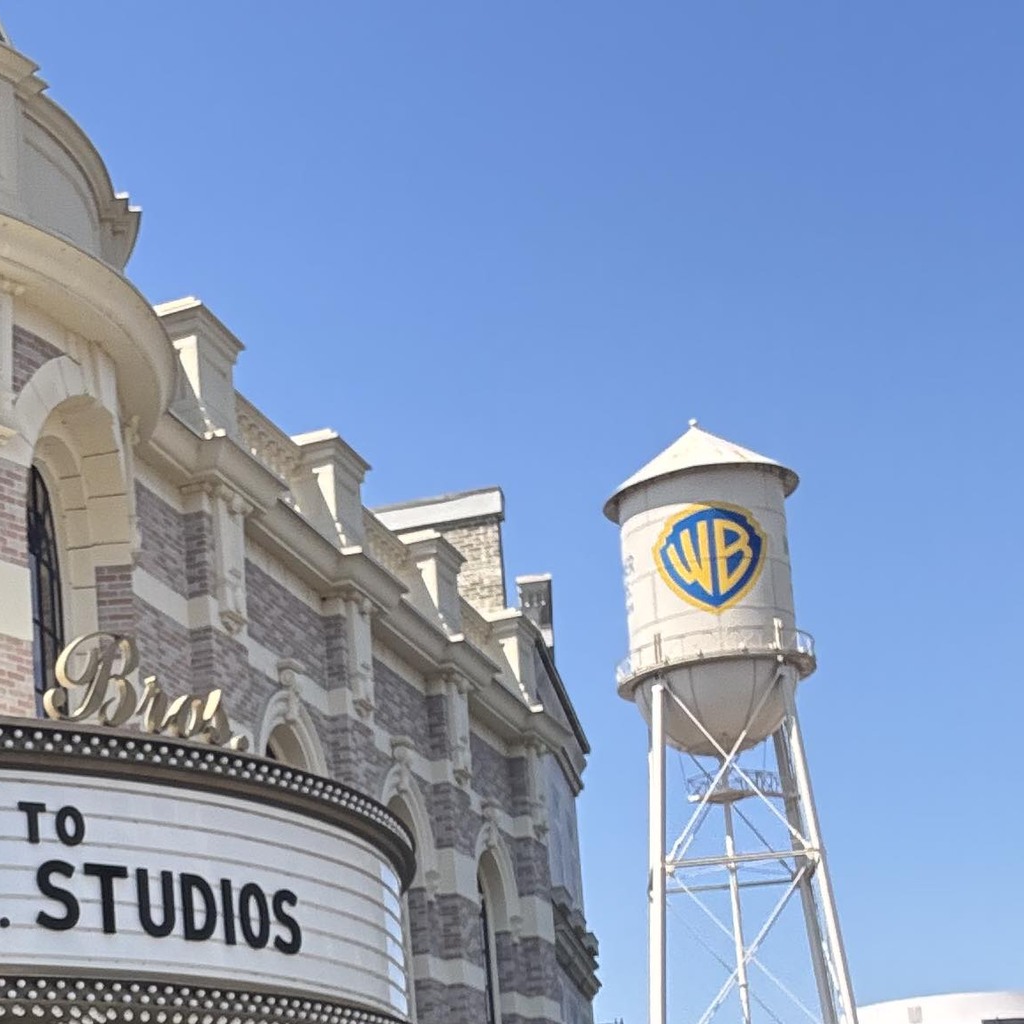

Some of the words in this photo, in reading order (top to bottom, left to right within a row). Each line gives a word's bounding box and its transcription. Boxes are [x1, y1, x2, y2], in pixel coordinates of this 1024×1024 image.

[666, 518, 753, 596] WB
[43, 631, 249, 750] Bros.
[18, 801, 86, 846] TO
[36, 859, 302, 954] STUDIOS
